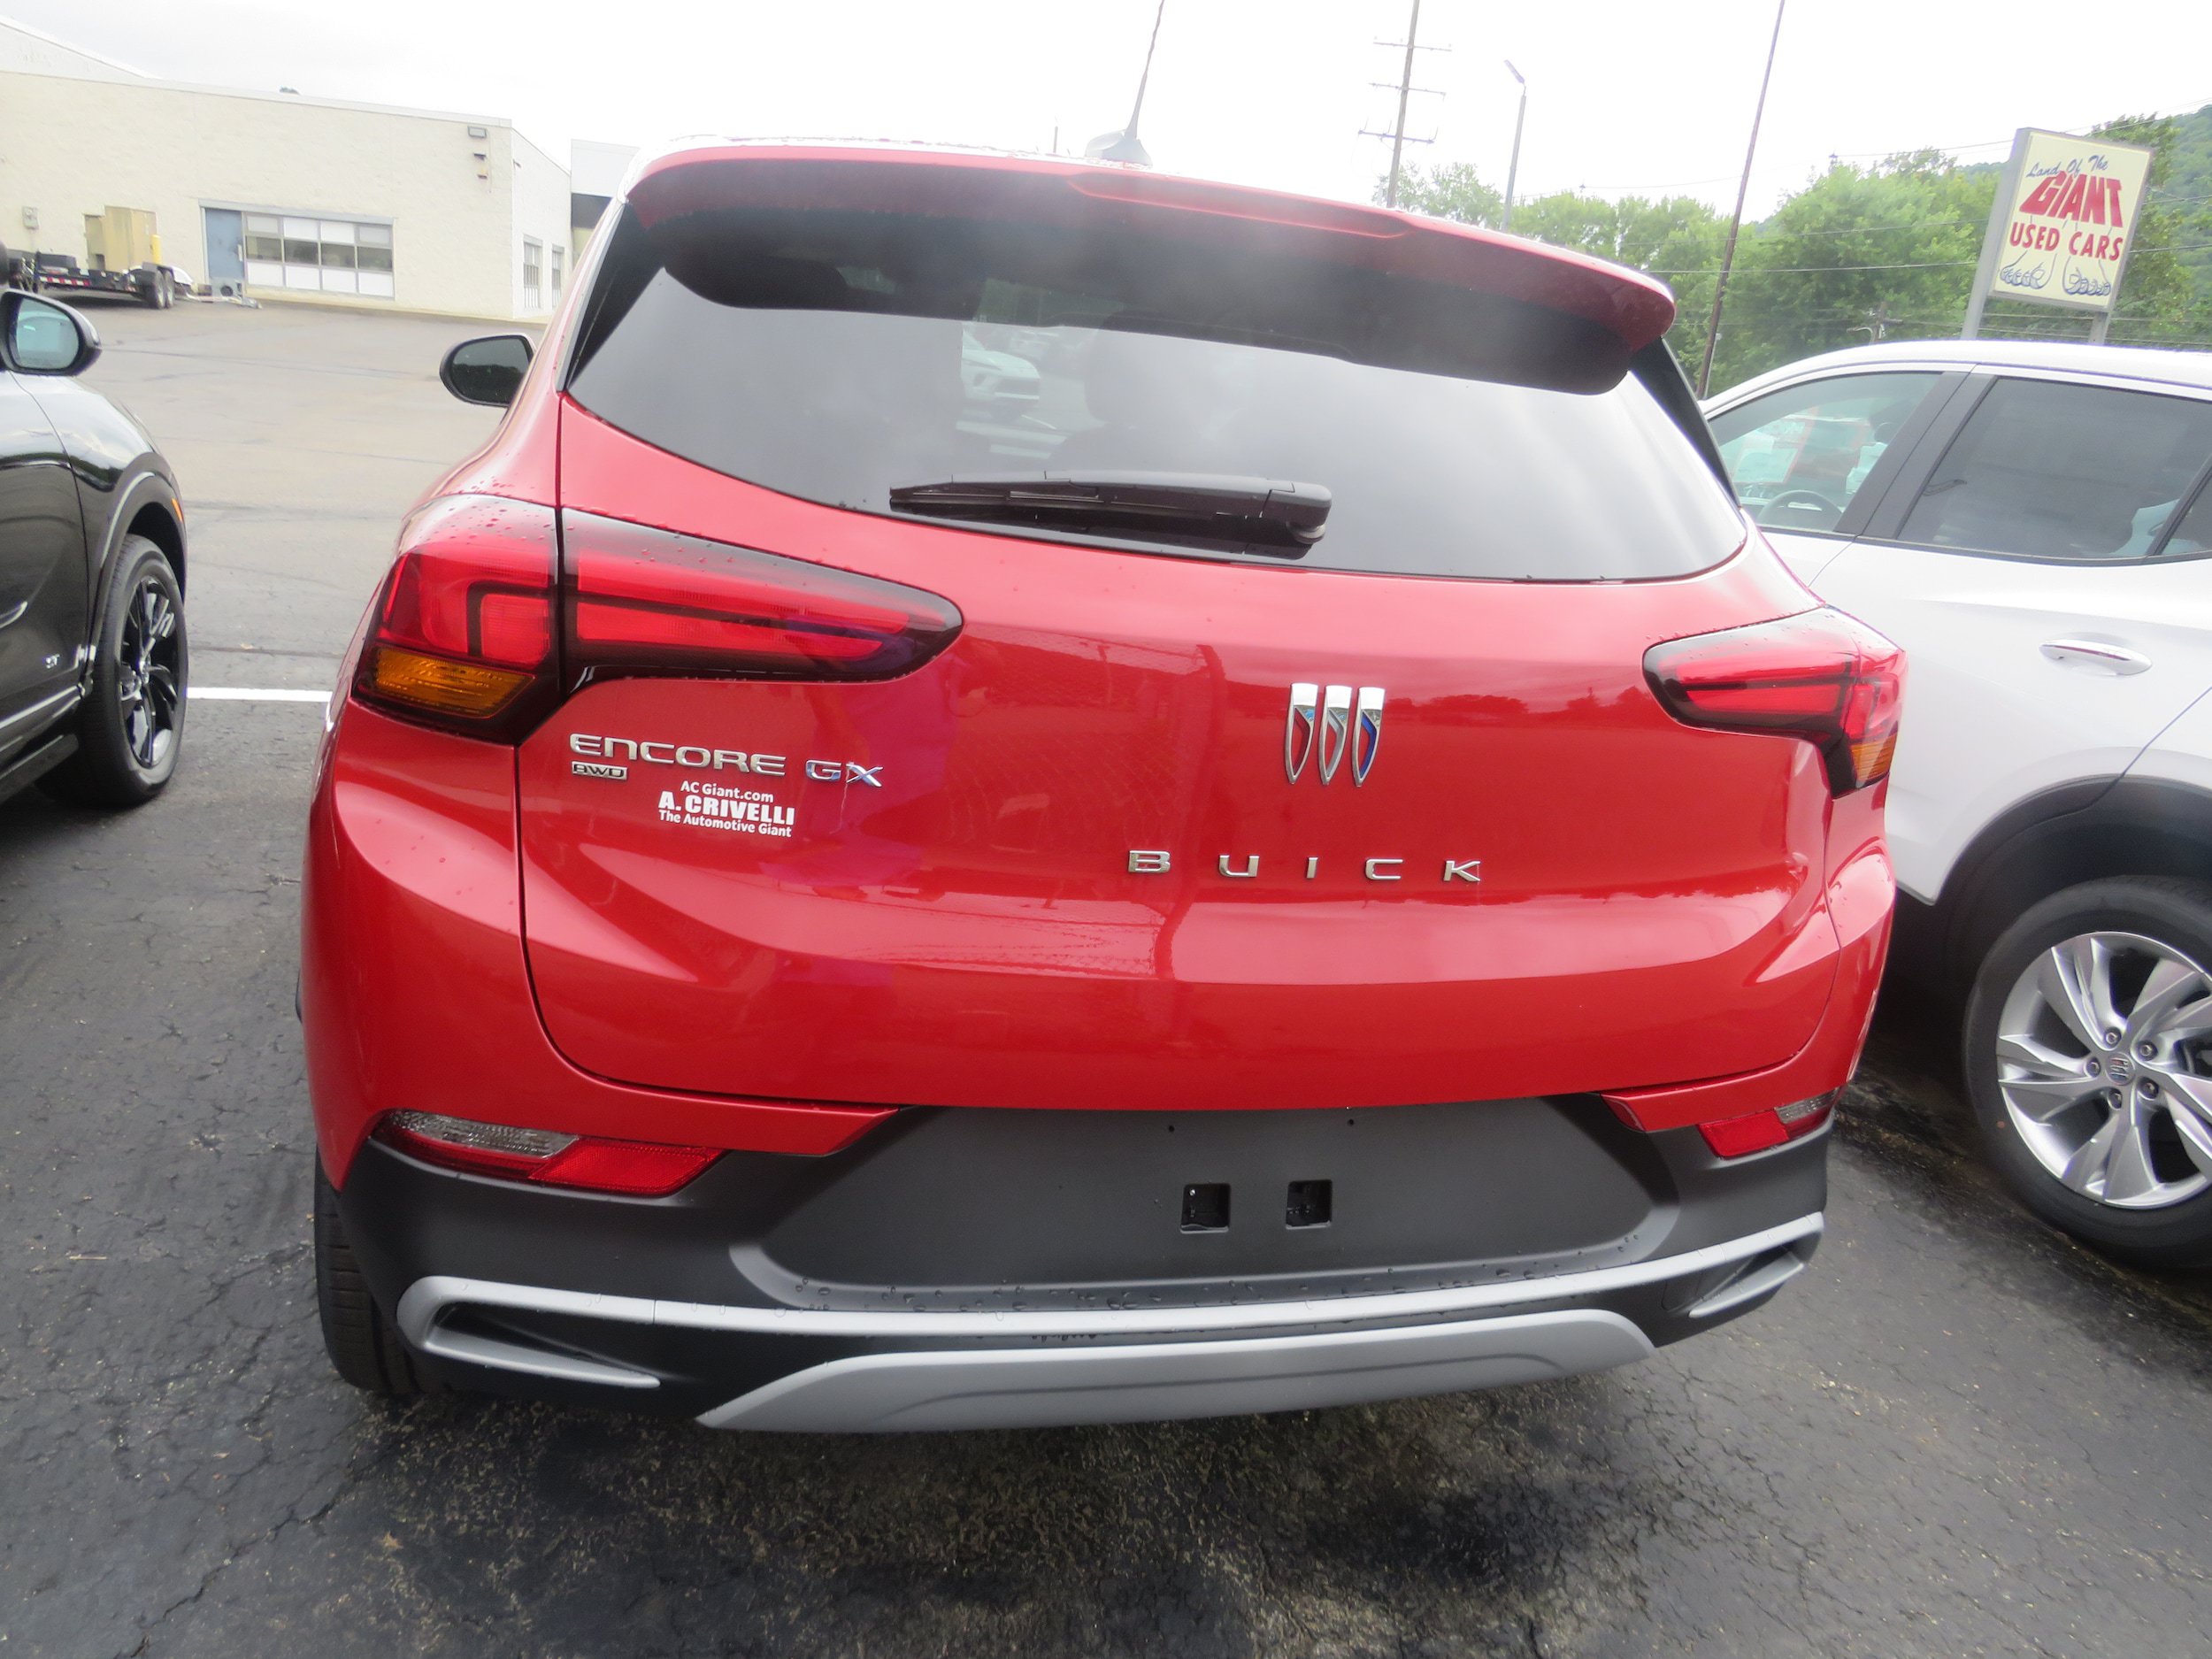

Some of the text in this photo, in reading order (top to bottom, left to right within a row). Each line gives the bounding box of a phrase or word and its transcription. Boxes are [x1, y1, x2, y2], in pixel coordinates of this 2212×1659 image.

[2025, 154, 2108, 178] Land Of The
[2018, 170, 2124, 228] GIANT
[2009, 221, 2124, 261] USED CARS
[569, 733, 884, 787] ENCORE GX
[572, 763, 626, 779] AWD
[658, 790, 795, 826] A. CRIVELLI
[680, 780, 774, 803] AC Giant.com
[658, 809, 792, 838] The Automotive Giant
[1127, 849, 1482, 883] BUICK
